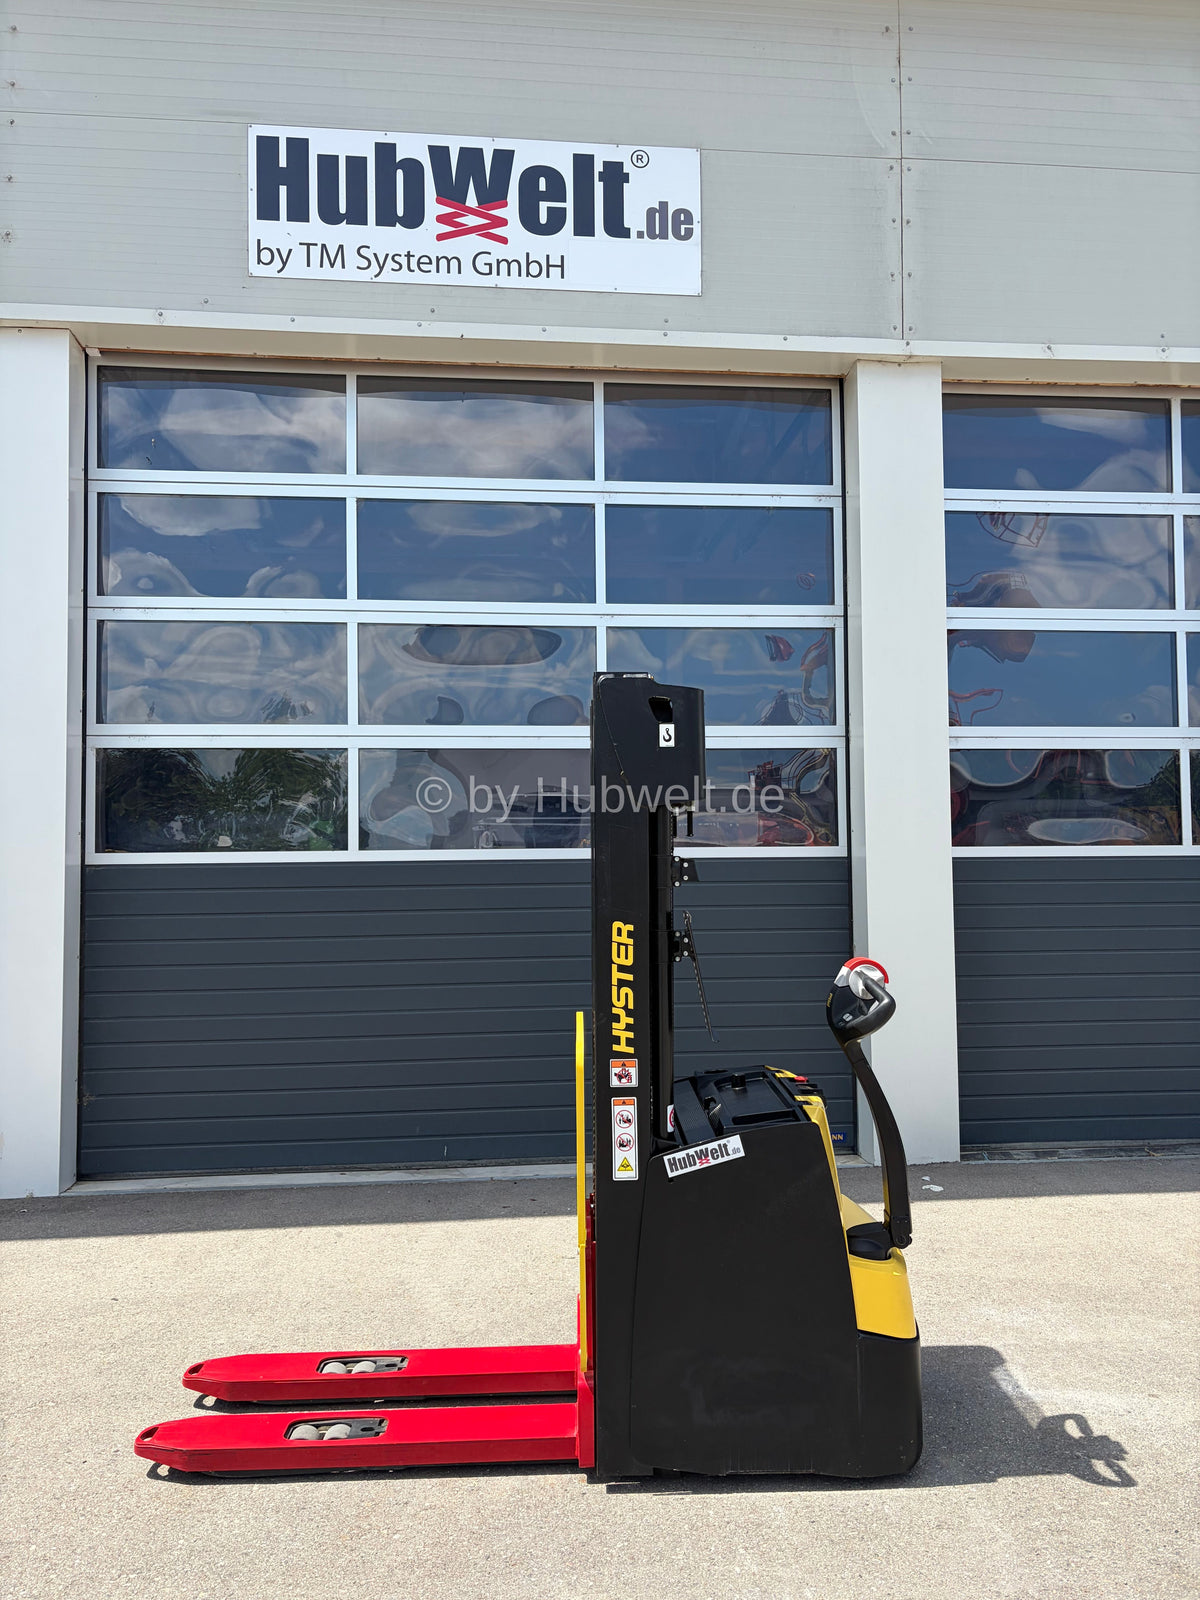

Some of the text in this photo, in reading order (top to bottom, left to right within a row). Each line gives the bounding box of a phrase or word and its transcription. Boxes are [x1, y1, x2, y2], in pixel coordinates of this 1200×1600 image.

[256, 239, 565, 280] by TM System GmbH
[611, 920, 635, 1054] HYSTER
